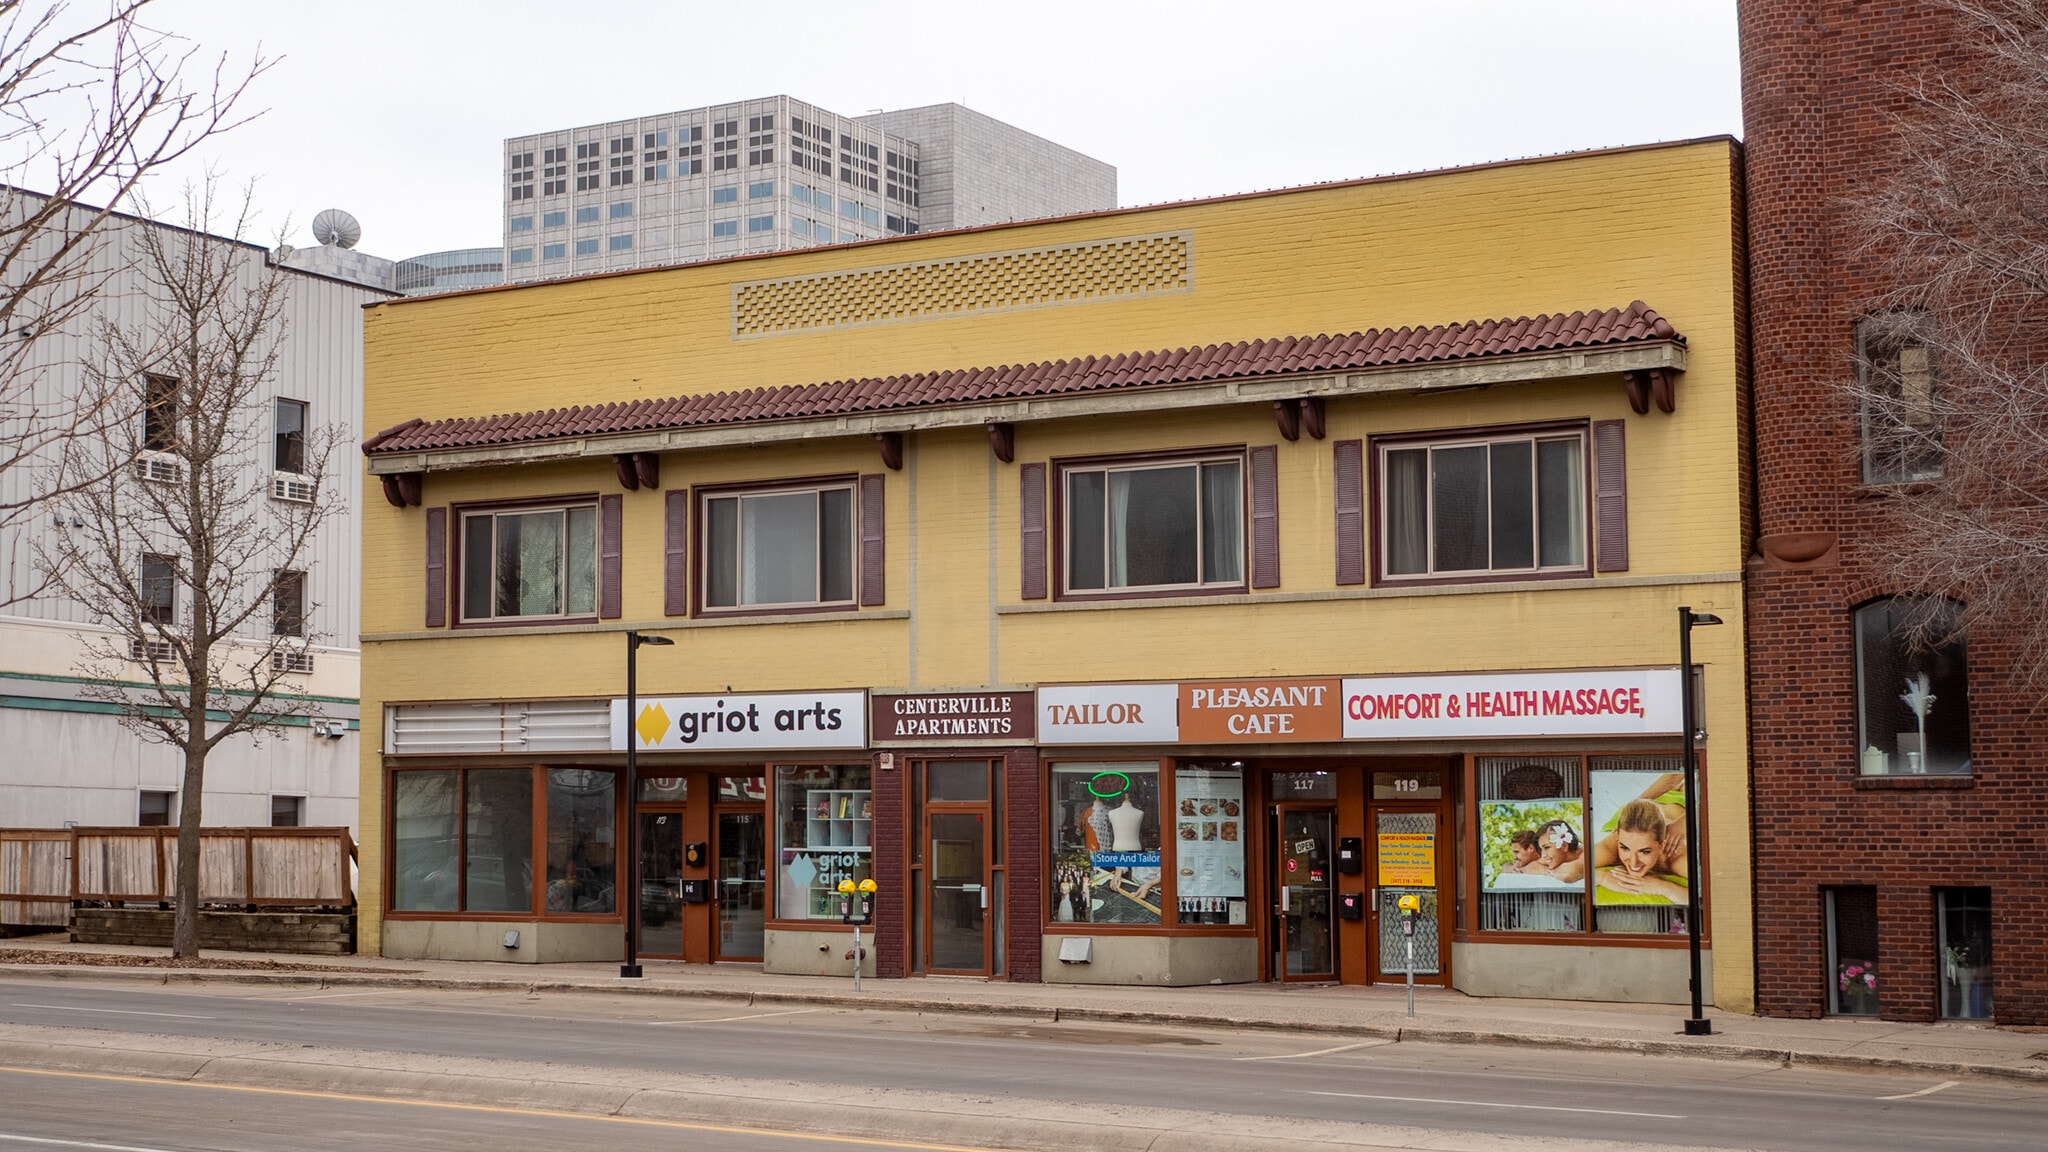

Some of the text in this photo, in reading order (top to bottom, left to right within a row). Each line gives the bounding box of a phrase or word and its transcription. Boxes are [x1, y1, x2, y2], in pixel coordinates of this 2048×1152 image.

[894, 697, 1011, 714] CENTERVILLE
[1191, 686, 1327, 709] PLEASANT
[1348, 687, 1645, 720] COMFORT & HEALTH MASSAGE,
[679, 700, 842, 743] griot arts
[1047, 703, 1144, 725] TAILOR
[895, 717, 1011, 735] APARTMENTS
[1228, 713, 1295, 735] CAFE
[1294, 780, 1314, 790] 117
[1394, 779, 1419, 792] 119
[656, 816, 668, 825] 113
[736, 815, 749, 823] 115
[1297, 841, 1313, 851] OPEN
[819, 850, 860, 871] griot
[1096, 854, 1118, 862] Store
[1120, 853, 1136, 862] And
[1138, 853, 1160, 862] Tailor
[819, 870, 852, 884] arts
